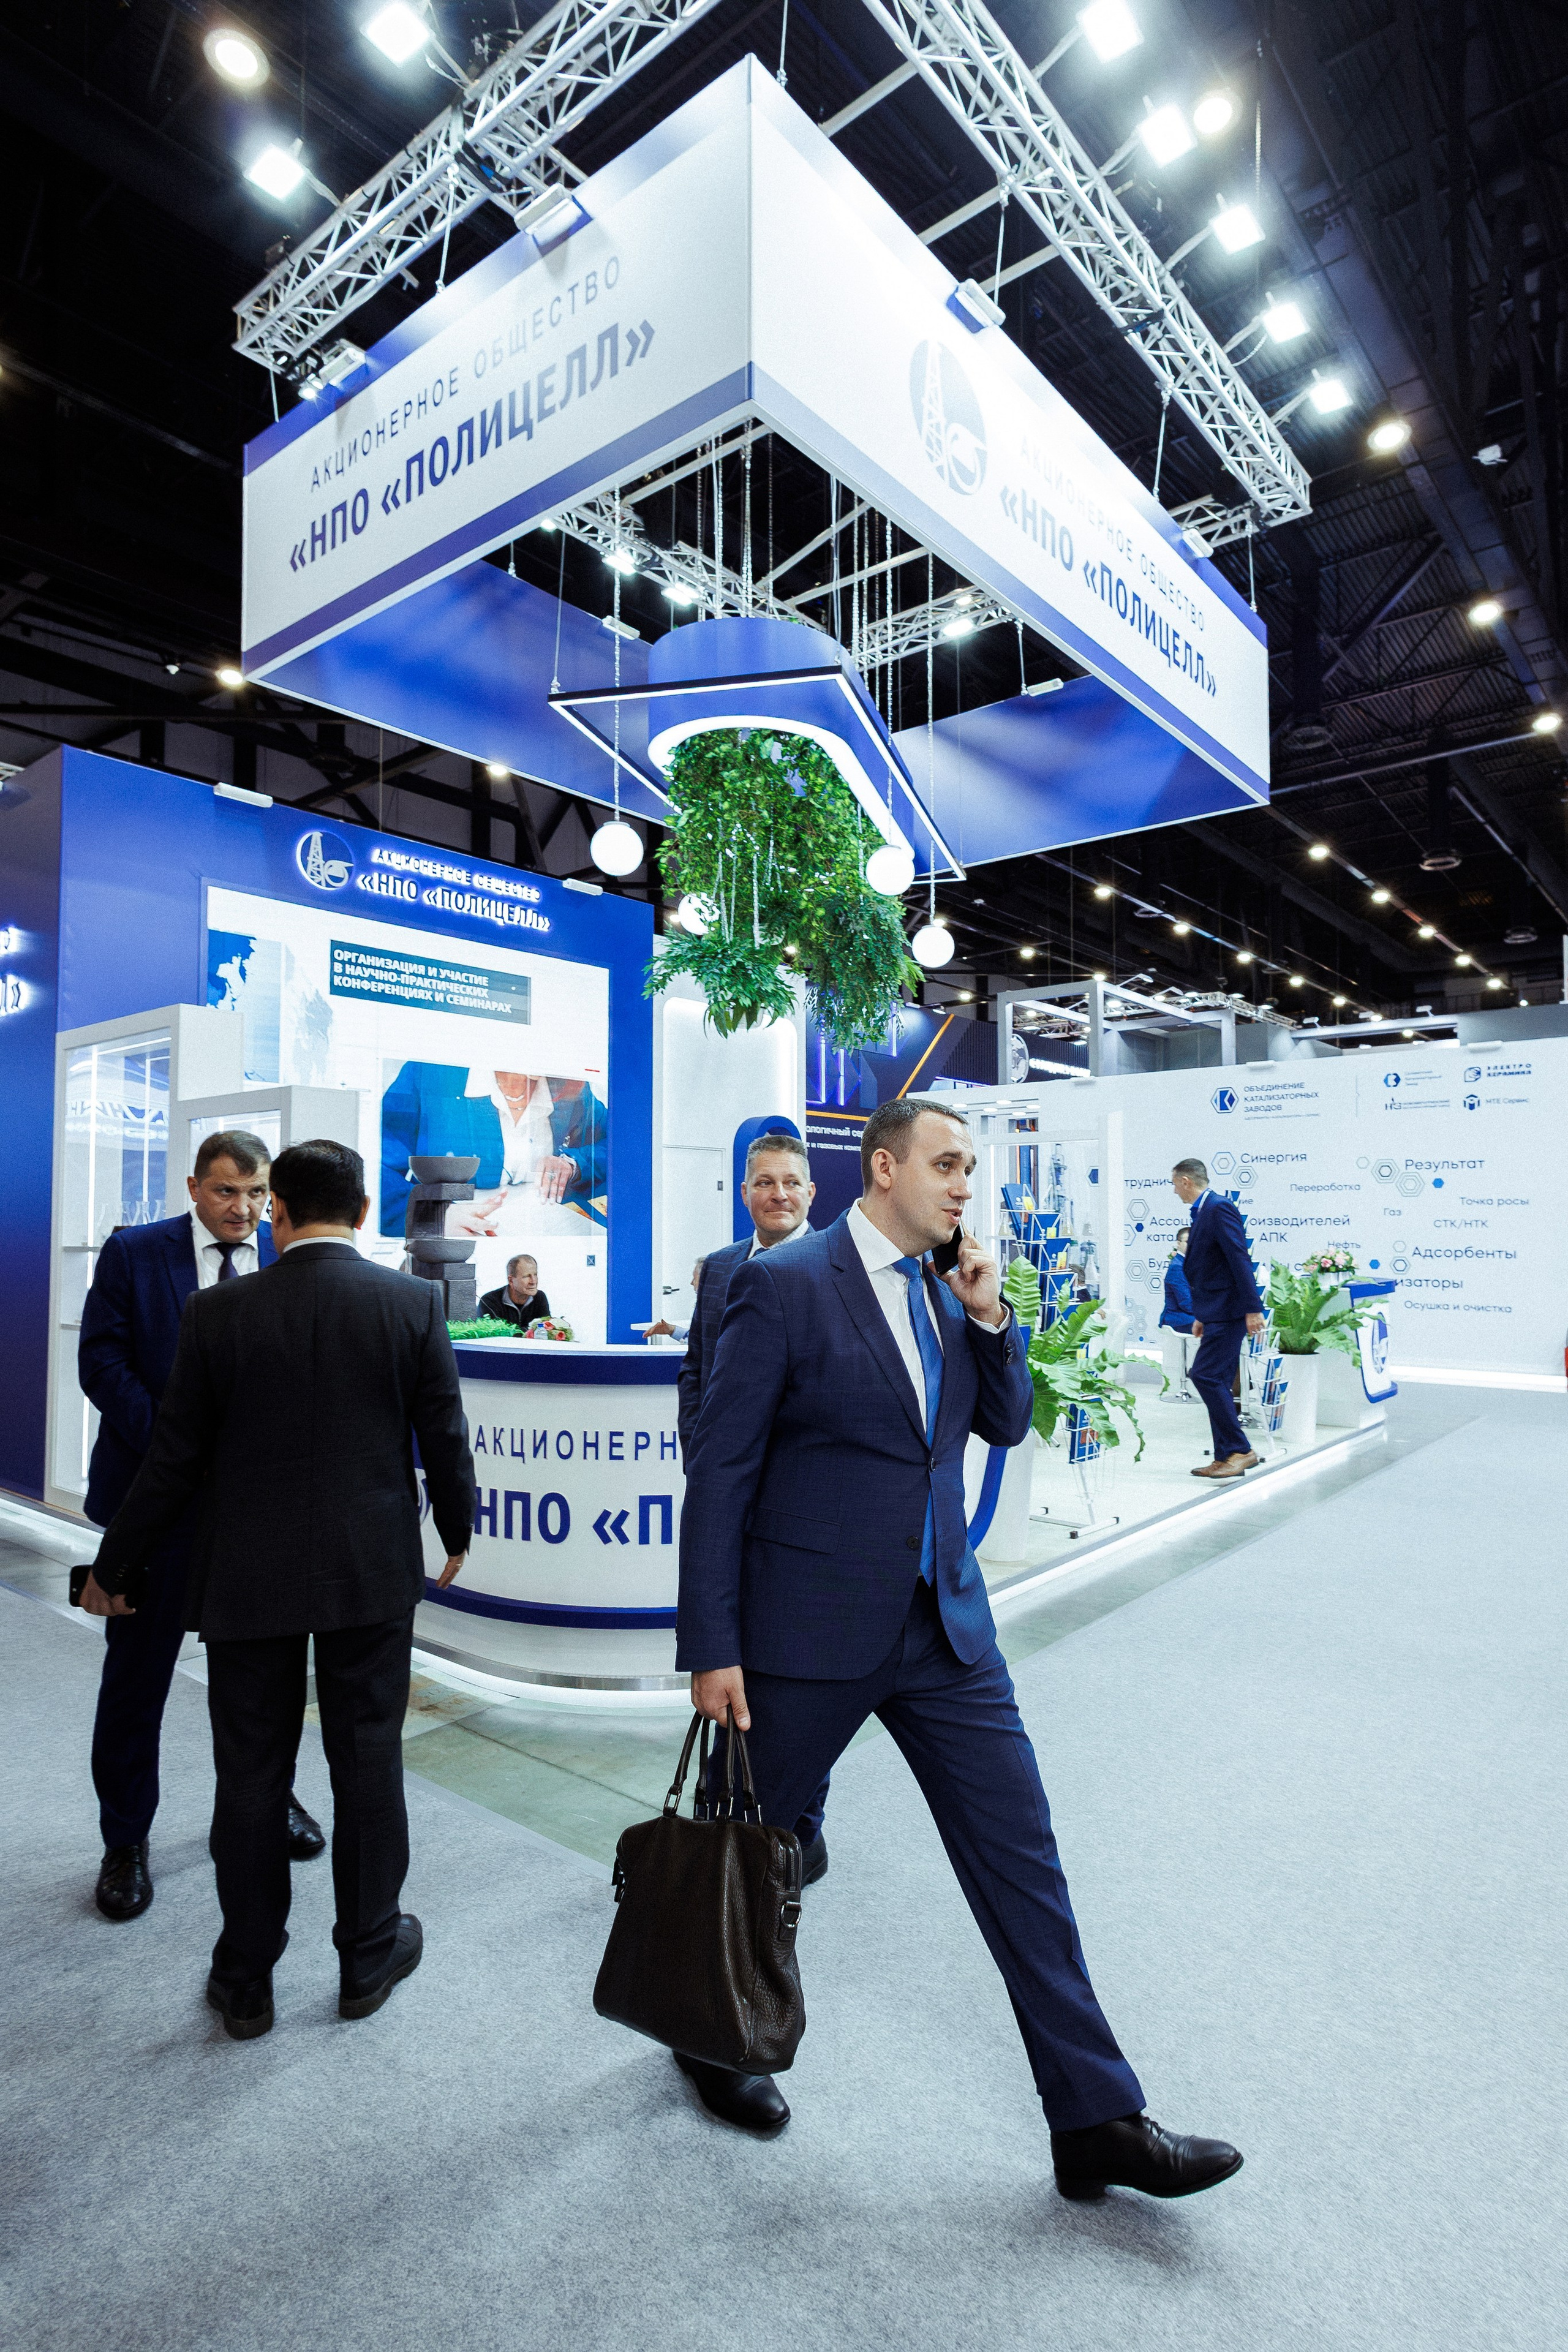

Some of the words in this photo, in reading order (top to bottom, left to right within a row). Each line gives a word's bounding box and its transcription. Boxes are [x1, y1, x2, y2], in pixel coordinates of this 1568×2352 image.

[311, 368, 458, 492] АКЦИОНЕРНОЕ
[474, 255, 619, 379] ОБЩЕСТВО
[289, 488, 369, 573] «НПО
[380, 319, 655, 516] «ПОЛИЦЕЛЛ»
[1020, 434, 1133, 560] АКЦИОНЕРНОЕ
[1142, 553, 1205, 631] ОБЩЕСТВО
[1000, 485, 1075, 571] «НПО
[1084, 560, 1217, 697] «ПОЛИЦЕЛЛ»
[356, 872, 418, 902] «НПО
[422, 886, 551, 932] «ПОЛИЦЕЛЛ»
[333, 949, 426, 975] ОРГАНИЗАЦИЯ
[428, 966, 439, 977] И
[439, 968, 489, 987] УЧАСТИЕ
[333, 962, 343, 973] В
[345, 963, 489, 998] НАУЧНО-ПРАКТИЧЕСКИХ
[333, 975, 433, 1000] КОНФЕРЕНЦИЯХ
[434, 992, 445, 1003] И
[446, 993, 512, 1014] СЕМИНАРАХ
[1243, 1082, 1305, 1092] ОБЪЕДИНЕНИЕ
[1243, 1092, 1319, 1102] КАТАЛИЗАТОРНЫХ
[1241, 1153, 1307, 1164] Синергия
[1405, 1159, 1485, 1172] Результат
[1290, 1183, 1361, 1193] Переработка
[1460, 1197, 1493, 1205] Точка
[1497, 1198, 1530, 1207] росы
[1249, 1215, 1351, 1228] оизводителей
[1433, 1219, 1489, 1229] СТК/НТК
[1259, 1232, 1289, 1243] АПК
[1412, 1246, 1517, 1261] Адсорбенты
[1404, 1300, 1449, 1311] Осушка
[1463, 1304, 1512, 1313] очистка
